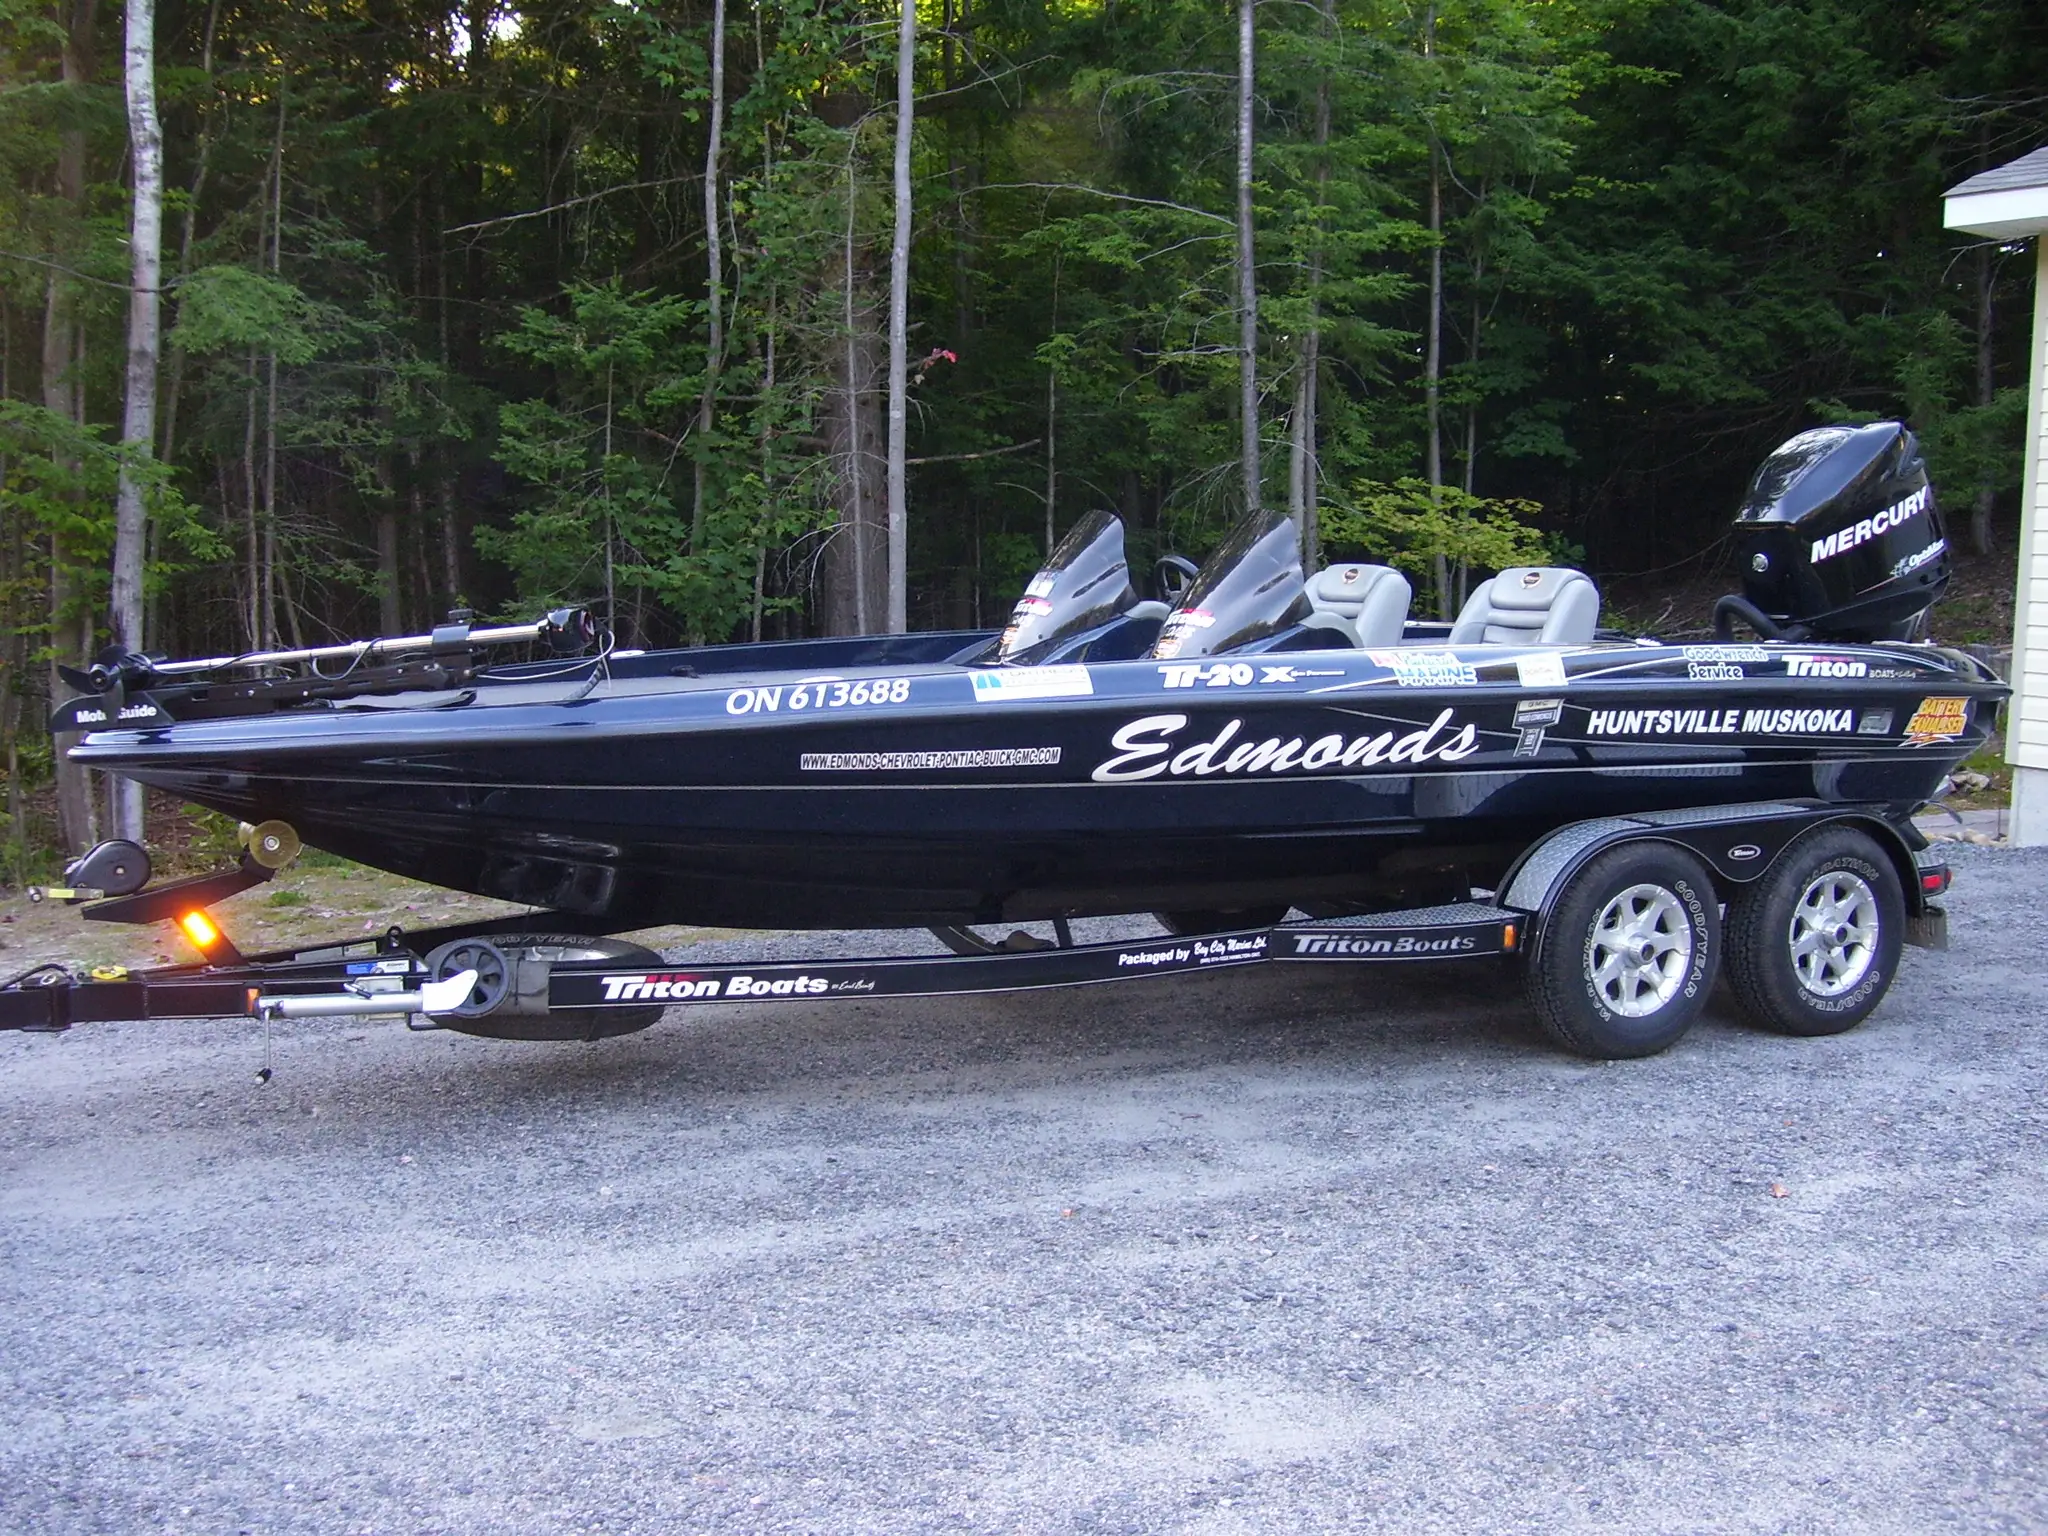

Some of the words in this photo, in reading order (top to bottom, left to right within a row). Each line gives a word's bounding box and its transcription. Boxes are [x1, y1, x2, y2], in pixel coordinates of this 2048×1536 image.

[1811, 486, 1928, 563] MERCURY
[1690, 663, 1742, 679] Service
[1782, 655, 1867, 678] Triton
[726, 687, 783, 715] ON
[788, 678, 911, 710] 613688
[1587, 710, 1739, 734] HUNTSVILLE
[1742, 709, 1853, 733] MUSKOKA
[1091, 707, 1480, 782] Edmonds
[1293, 935, 1392, 953] Triton
[1394, 936, 1476, 952] Boats
[1675, 880, 1708, 998] GOODYEAR
[1118, 949, 1174, 966] Packaged
[1176, 949, 1190, 961] by
[601, 975, 720, 1000] Triton
[725, 976, 828, 996] Boats
